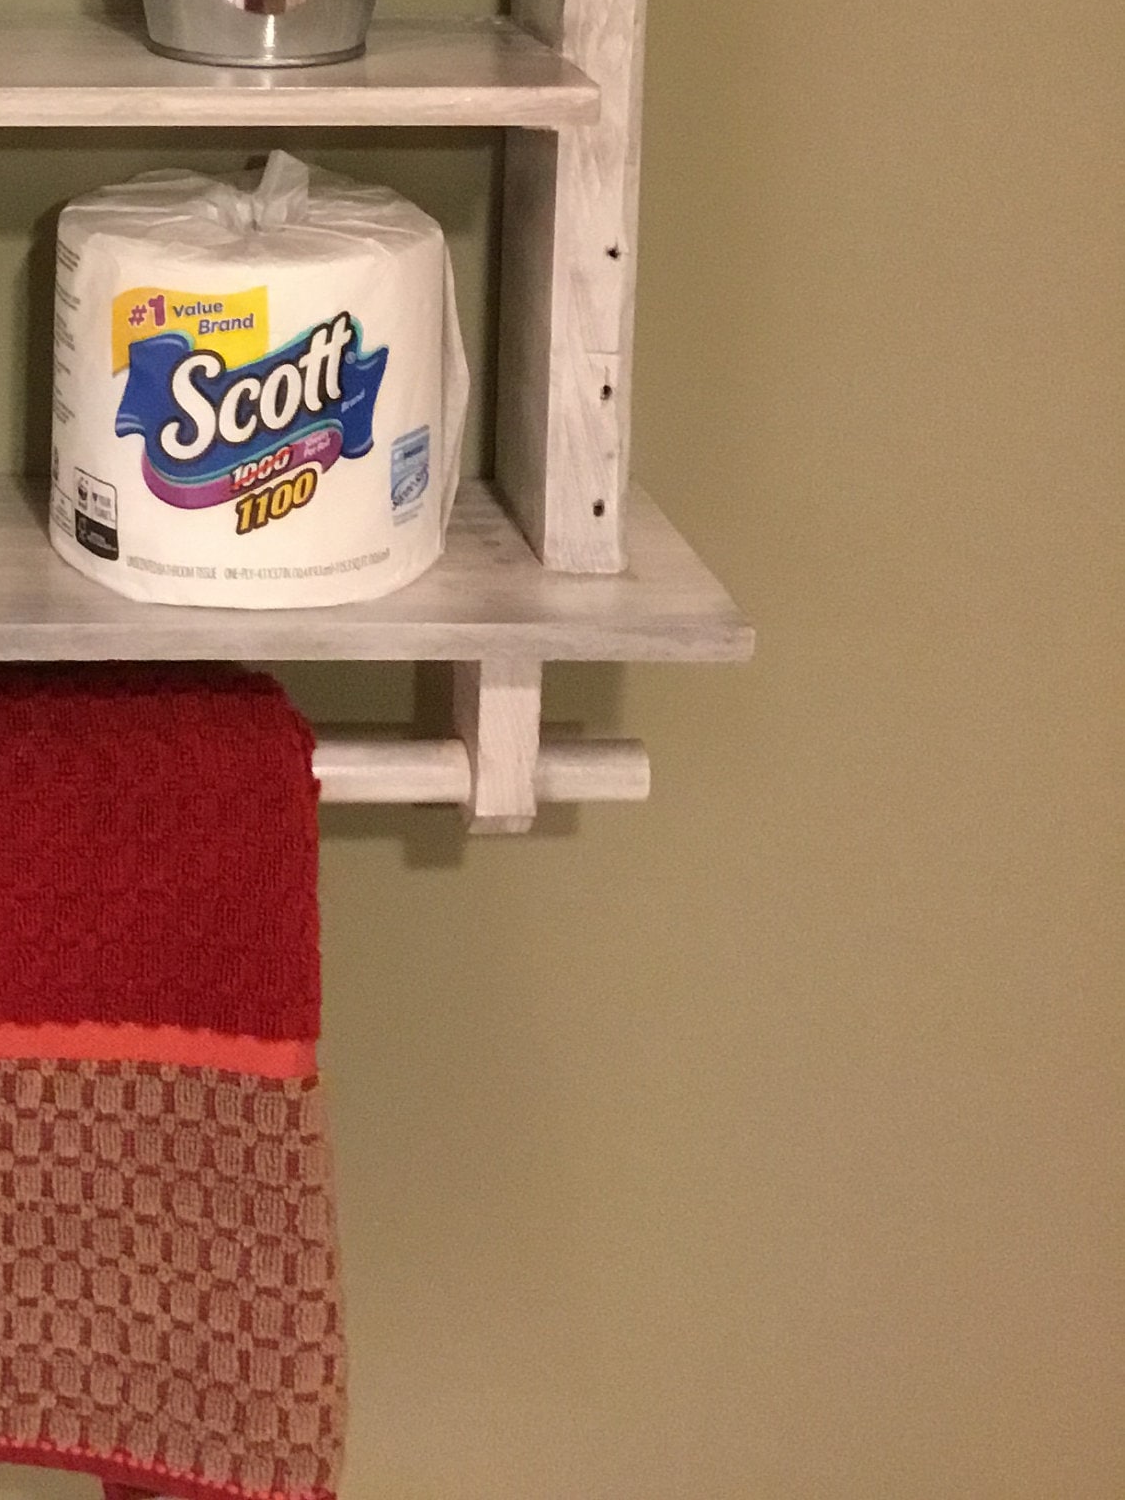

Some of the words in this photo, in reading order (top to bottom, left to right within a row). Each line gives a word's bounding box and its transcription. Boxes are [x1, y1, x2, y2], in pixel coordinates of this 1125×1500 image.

[128, 294, 166, 327] #1
[172, 301, 223, 318] Value
[197, 313, 254, 335] Brand
[159, 312, 351, 461] Scott
[231, 445, 293, 490] 1000
[235, 467, 318, 535] 1100
